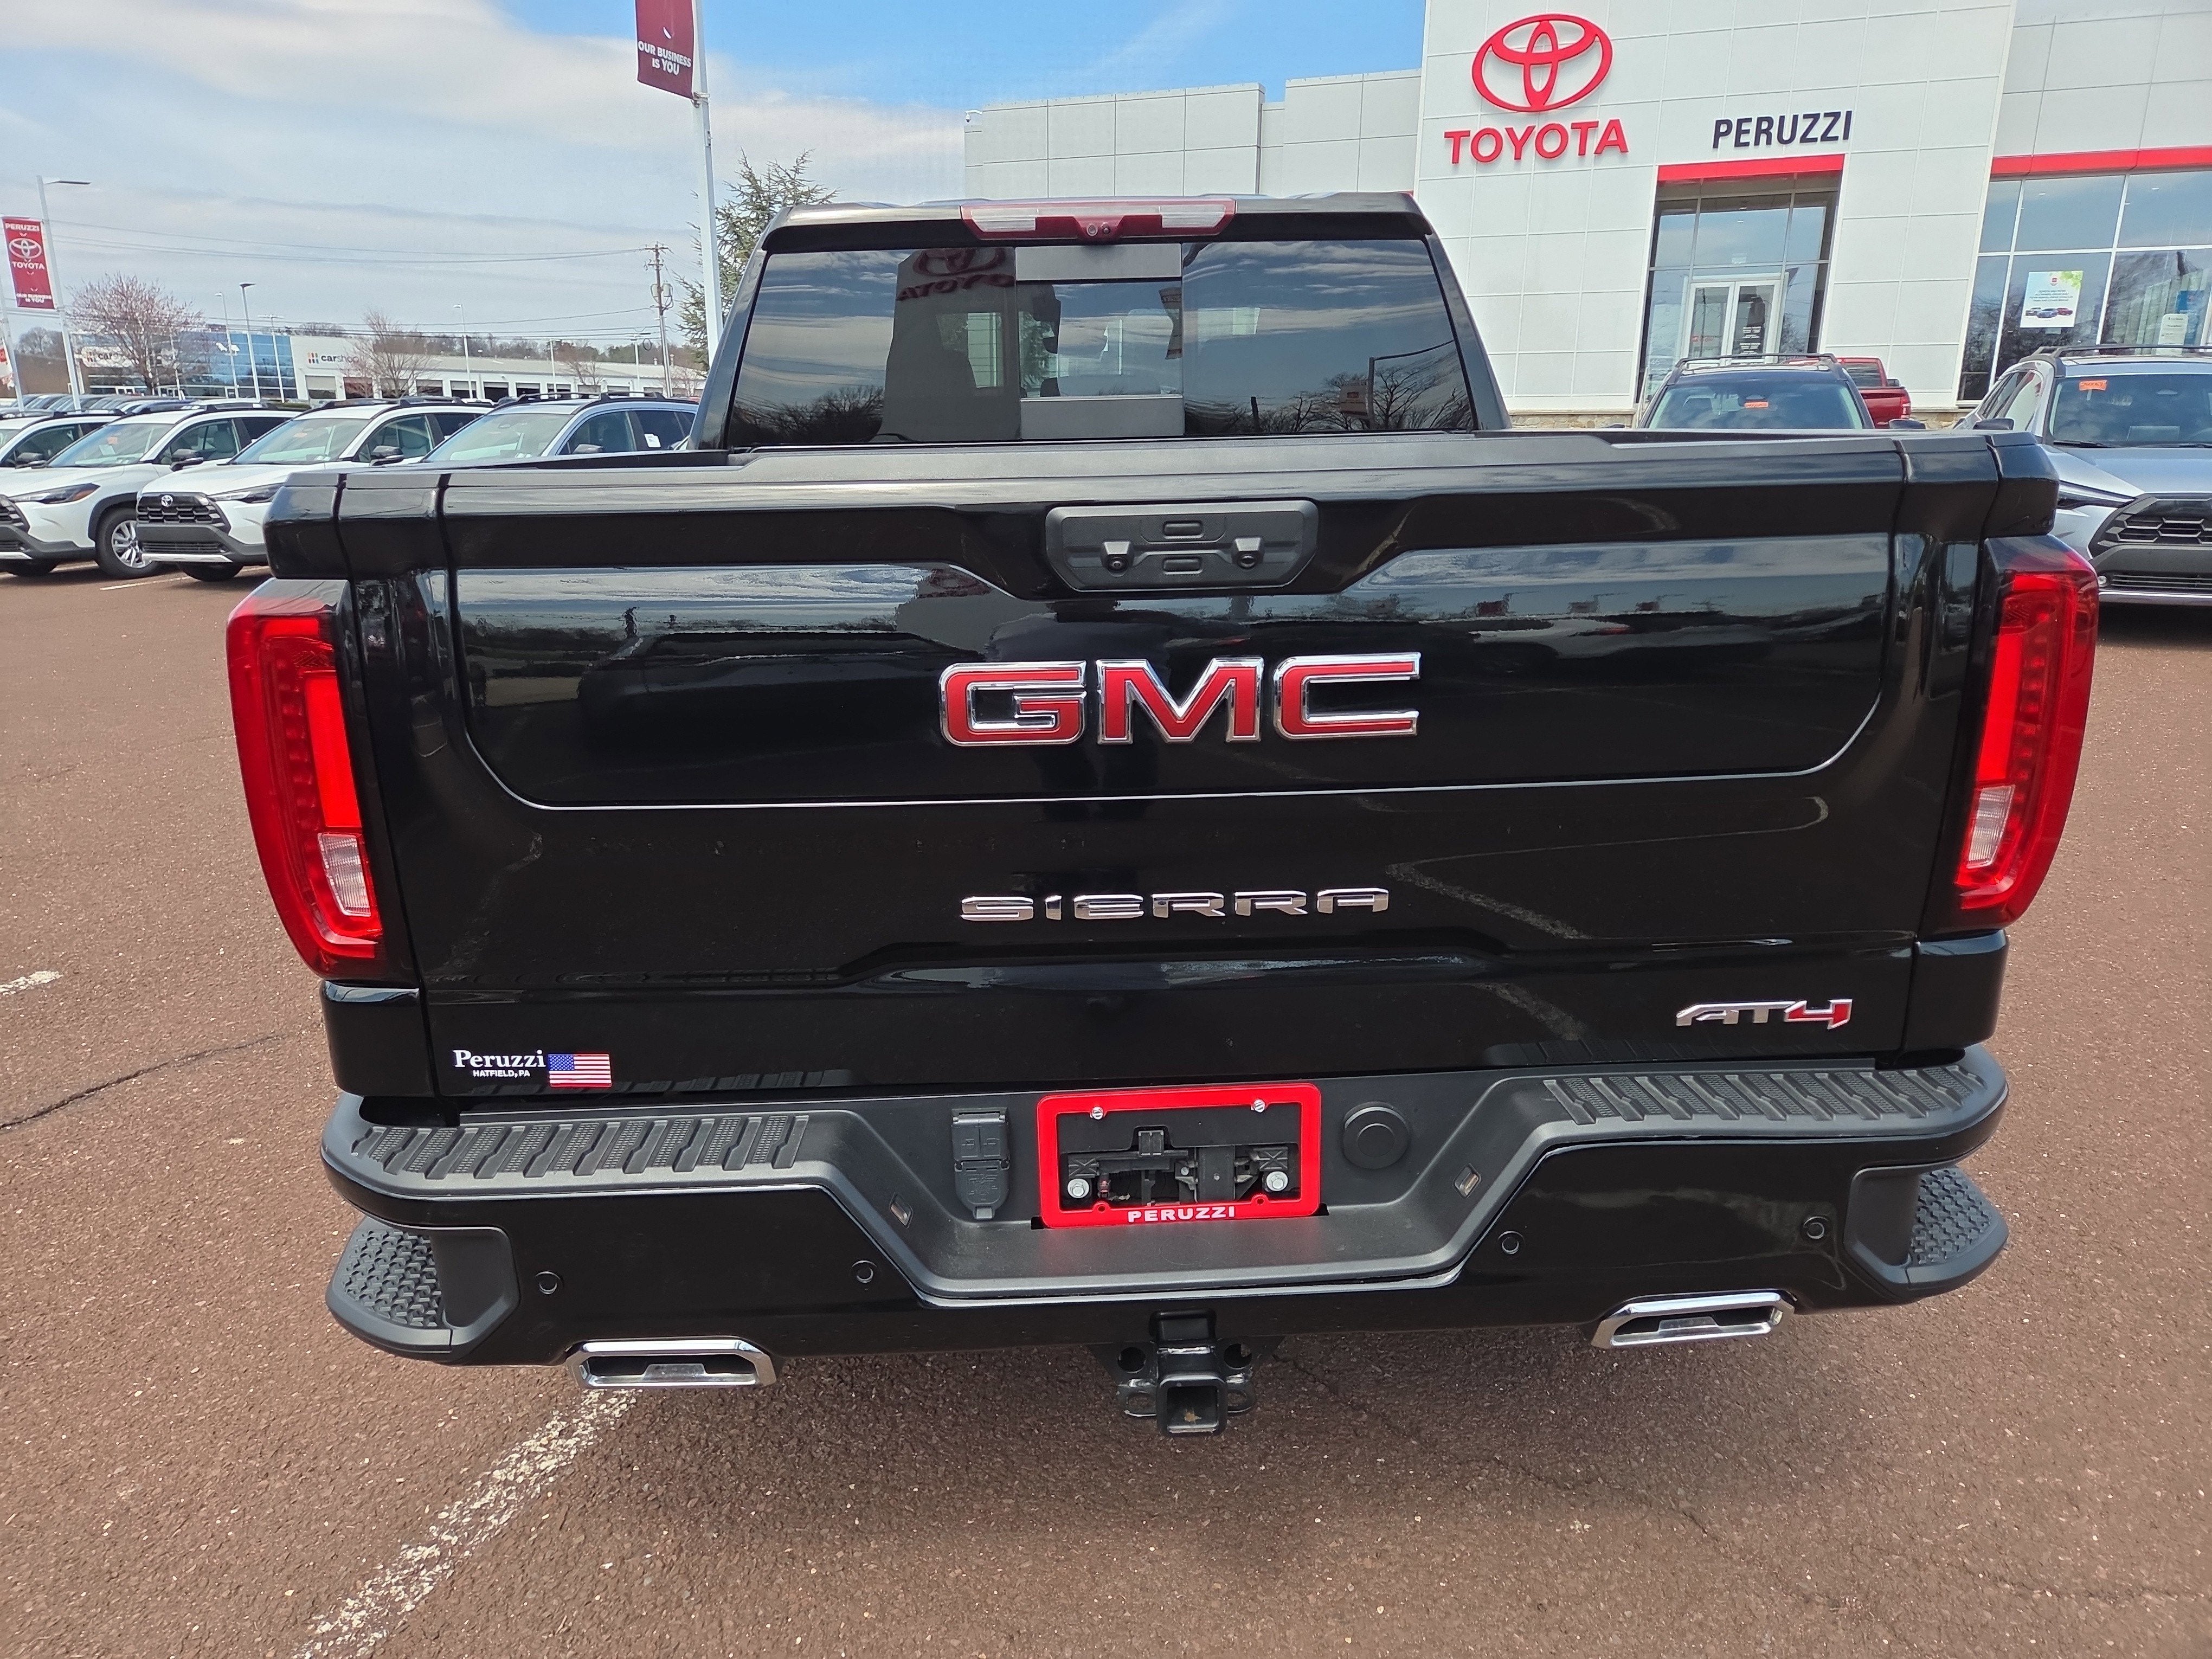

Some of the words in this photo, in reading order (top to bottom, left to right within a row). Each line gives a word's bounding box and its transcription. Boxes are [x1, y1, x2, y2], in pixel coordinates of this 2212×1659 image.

[638, 41, 656, 55] OUR
[657, 47, 692, 68] BUSINESS
[652, 57, 660, 69] IS
[661, 58, 680, 75] YOU
[1443, 118, 1629, 164] TOYOTA
[1712, 110, 1853, 149] PERUZZI
[5, 222, 40, 232] PERUZZI
[12, 261, 45, 270] TOYOTA
[321, 354, 359, 363] carshop
[938, 652, 1422, 747] GMC
[959, 887, 1390, 921] SIERRA
[1675, 998, 1853, 1030] AT4
[453, 1049, 546, 1068] Peruzzi
[1127, 1206, 1235, 1223] PERUZZI
